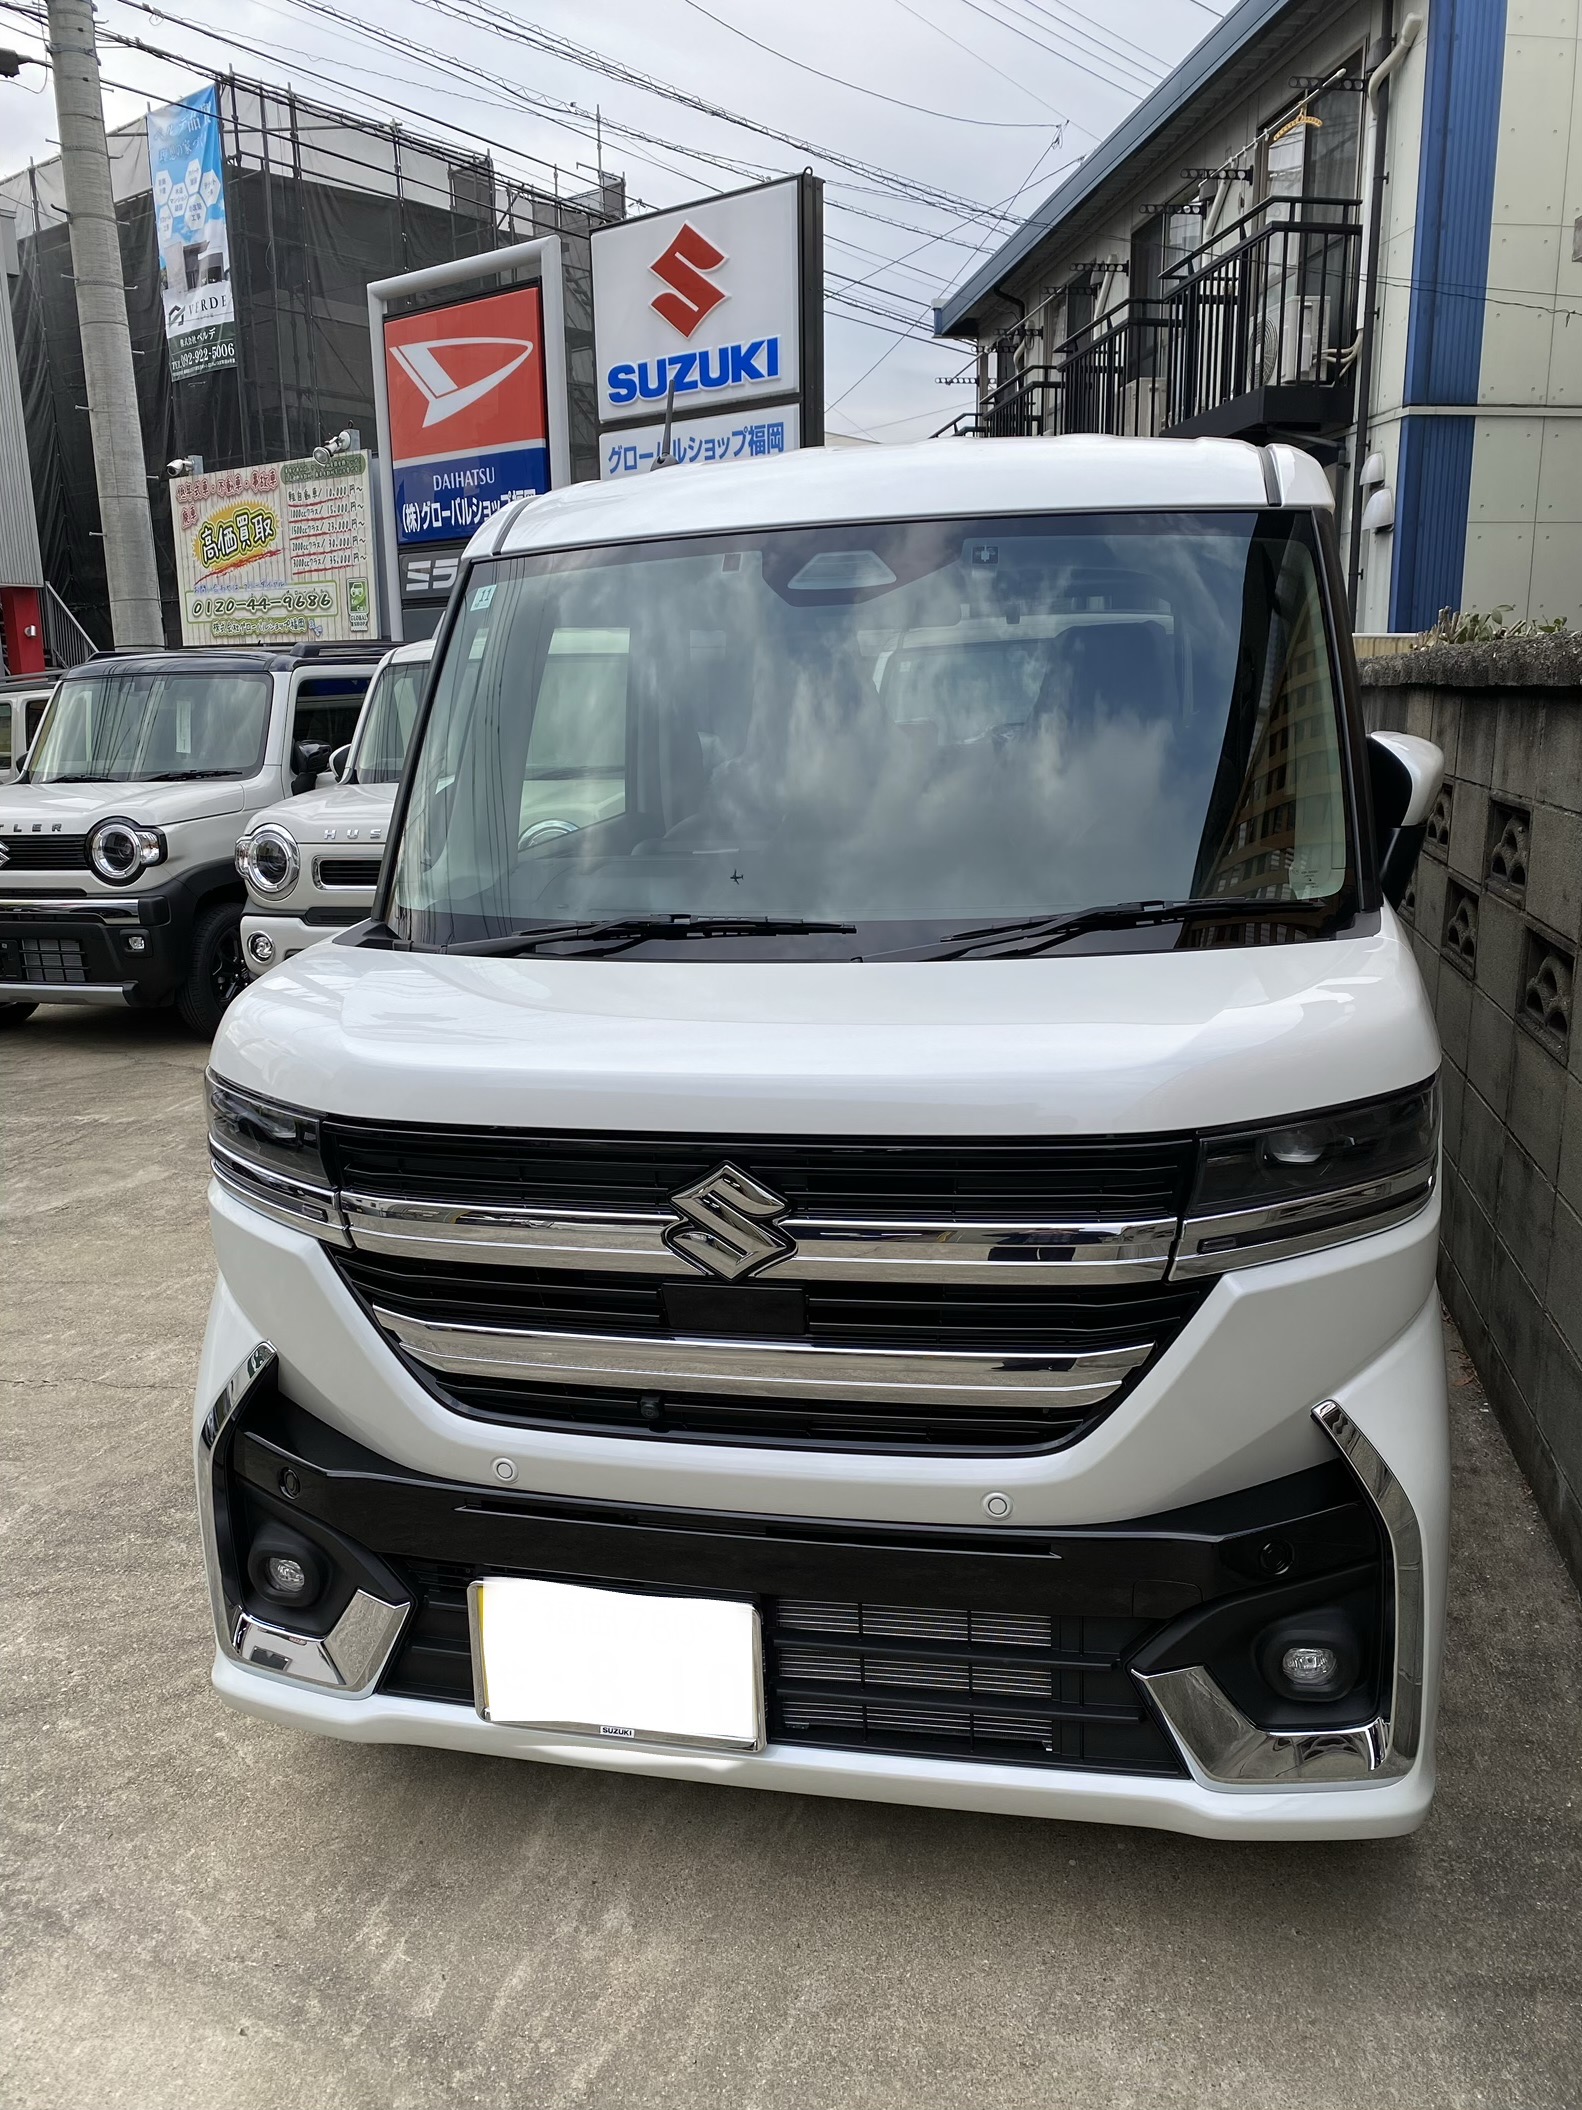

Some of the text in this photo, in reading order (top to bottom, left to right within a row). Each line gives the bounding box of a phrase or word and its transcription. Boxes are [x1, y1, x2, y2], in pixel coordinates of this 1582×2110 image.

[188, 294, 227, 316] VERDE
[607, 336, 779, 404] SUZUKI
[433, 466, 495, 491] DAIHATSU
[201, 513, 273, 563] 高価買取
[193, 593, 331, 615] 0120-44-9686
[324, 829, 381, 840] HUS
[602, 1726, 632, 1736] SUZUKI
